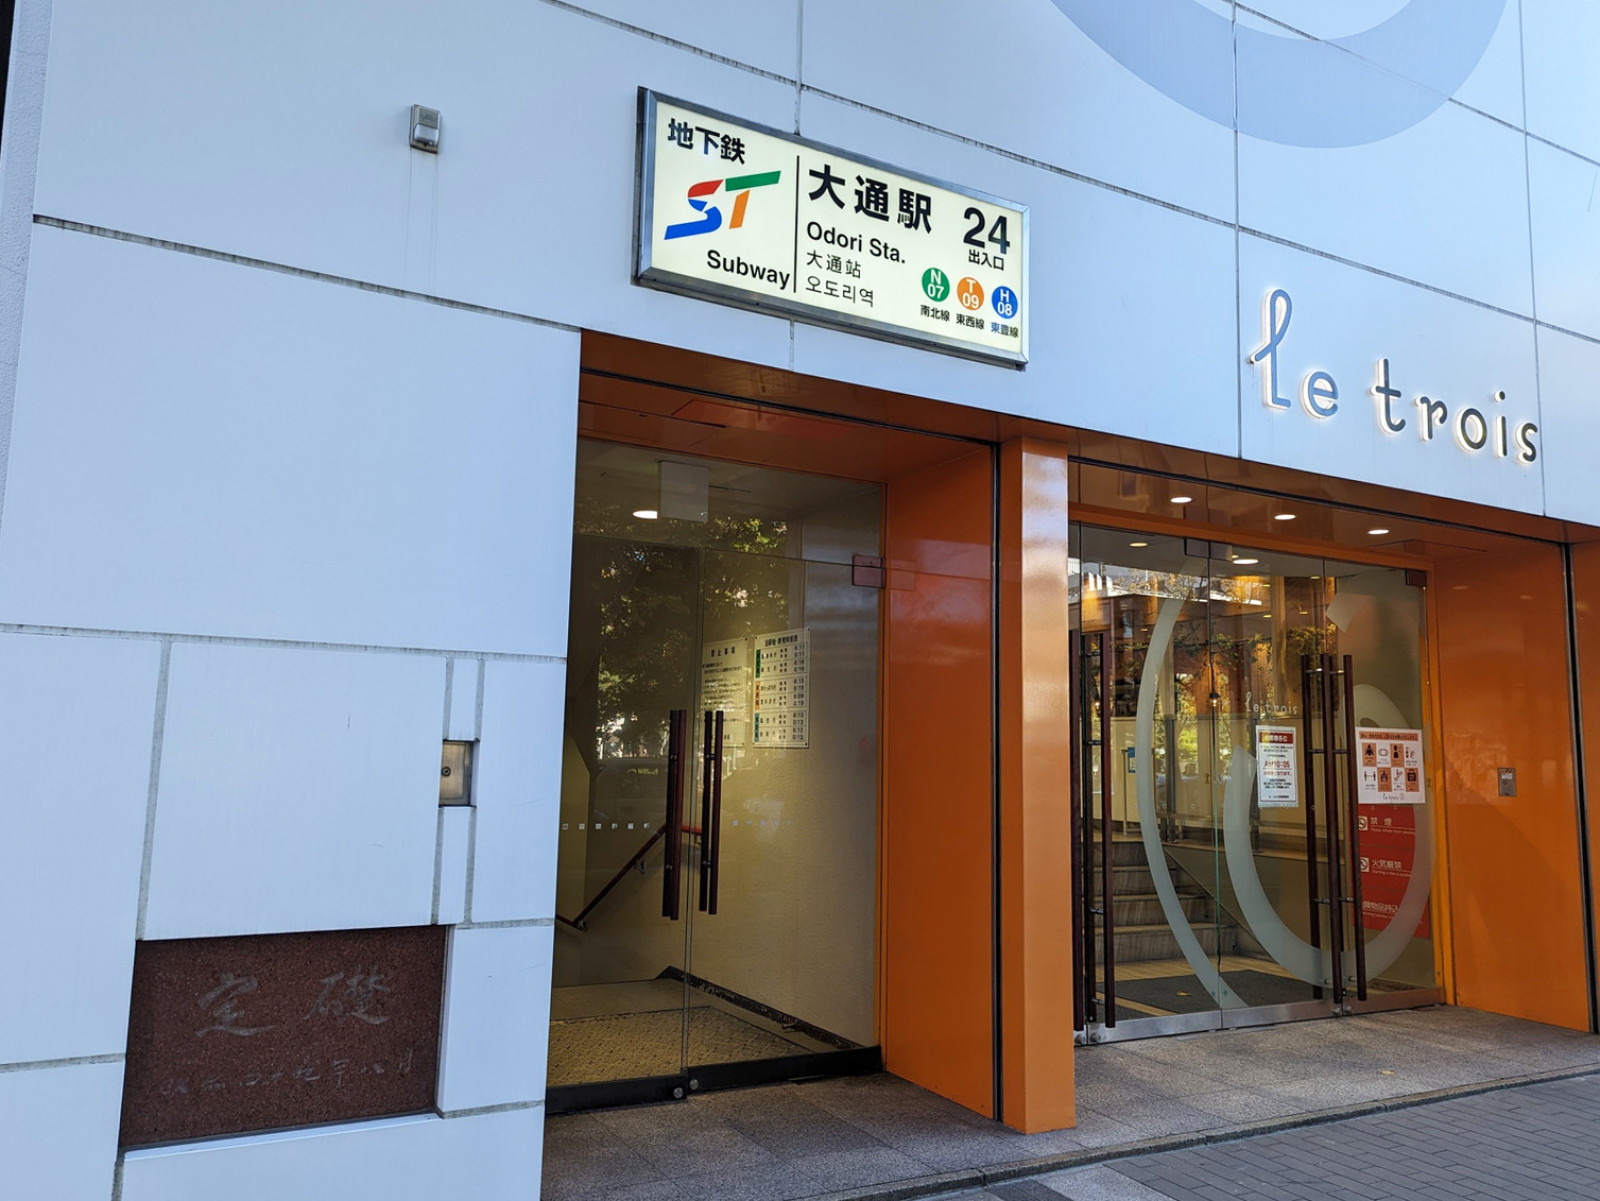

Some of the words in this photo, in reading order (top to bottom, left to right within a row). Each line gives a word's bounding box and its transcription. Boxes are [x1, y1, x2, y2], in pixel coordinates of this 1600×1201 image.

[668, 118, 745, 164] 地下鉄
[808, 164, 931, 234] 大通駅
[963, 207, 1010, 254] 24
[807, 221, 862, 253] Odori
[869, 237, 906, 264] Sta.
[806, 249, 861, 279] 大通站
[968, 249, 1004, 271] 出入口
[706, 250, 790, 290] Subway
[930, 269, 941, 284] N
[805, 275, 874, 307] 오도리역
[927, 284, 944, 299] 07
[966, 278, 976, 294] T
[962, 293, 979, 309] 09
[1000, 289, 1009, 302] H
[920, 305, 950, 321] 南北線
[997, 302, 1013, 317] 08
[956, 314, 985, 330] 東西線
[990, 322, 1019, 338] 東豊線
[1370, 358, 1539, 463] trois
[1265, 700, 1298, 715] trois
